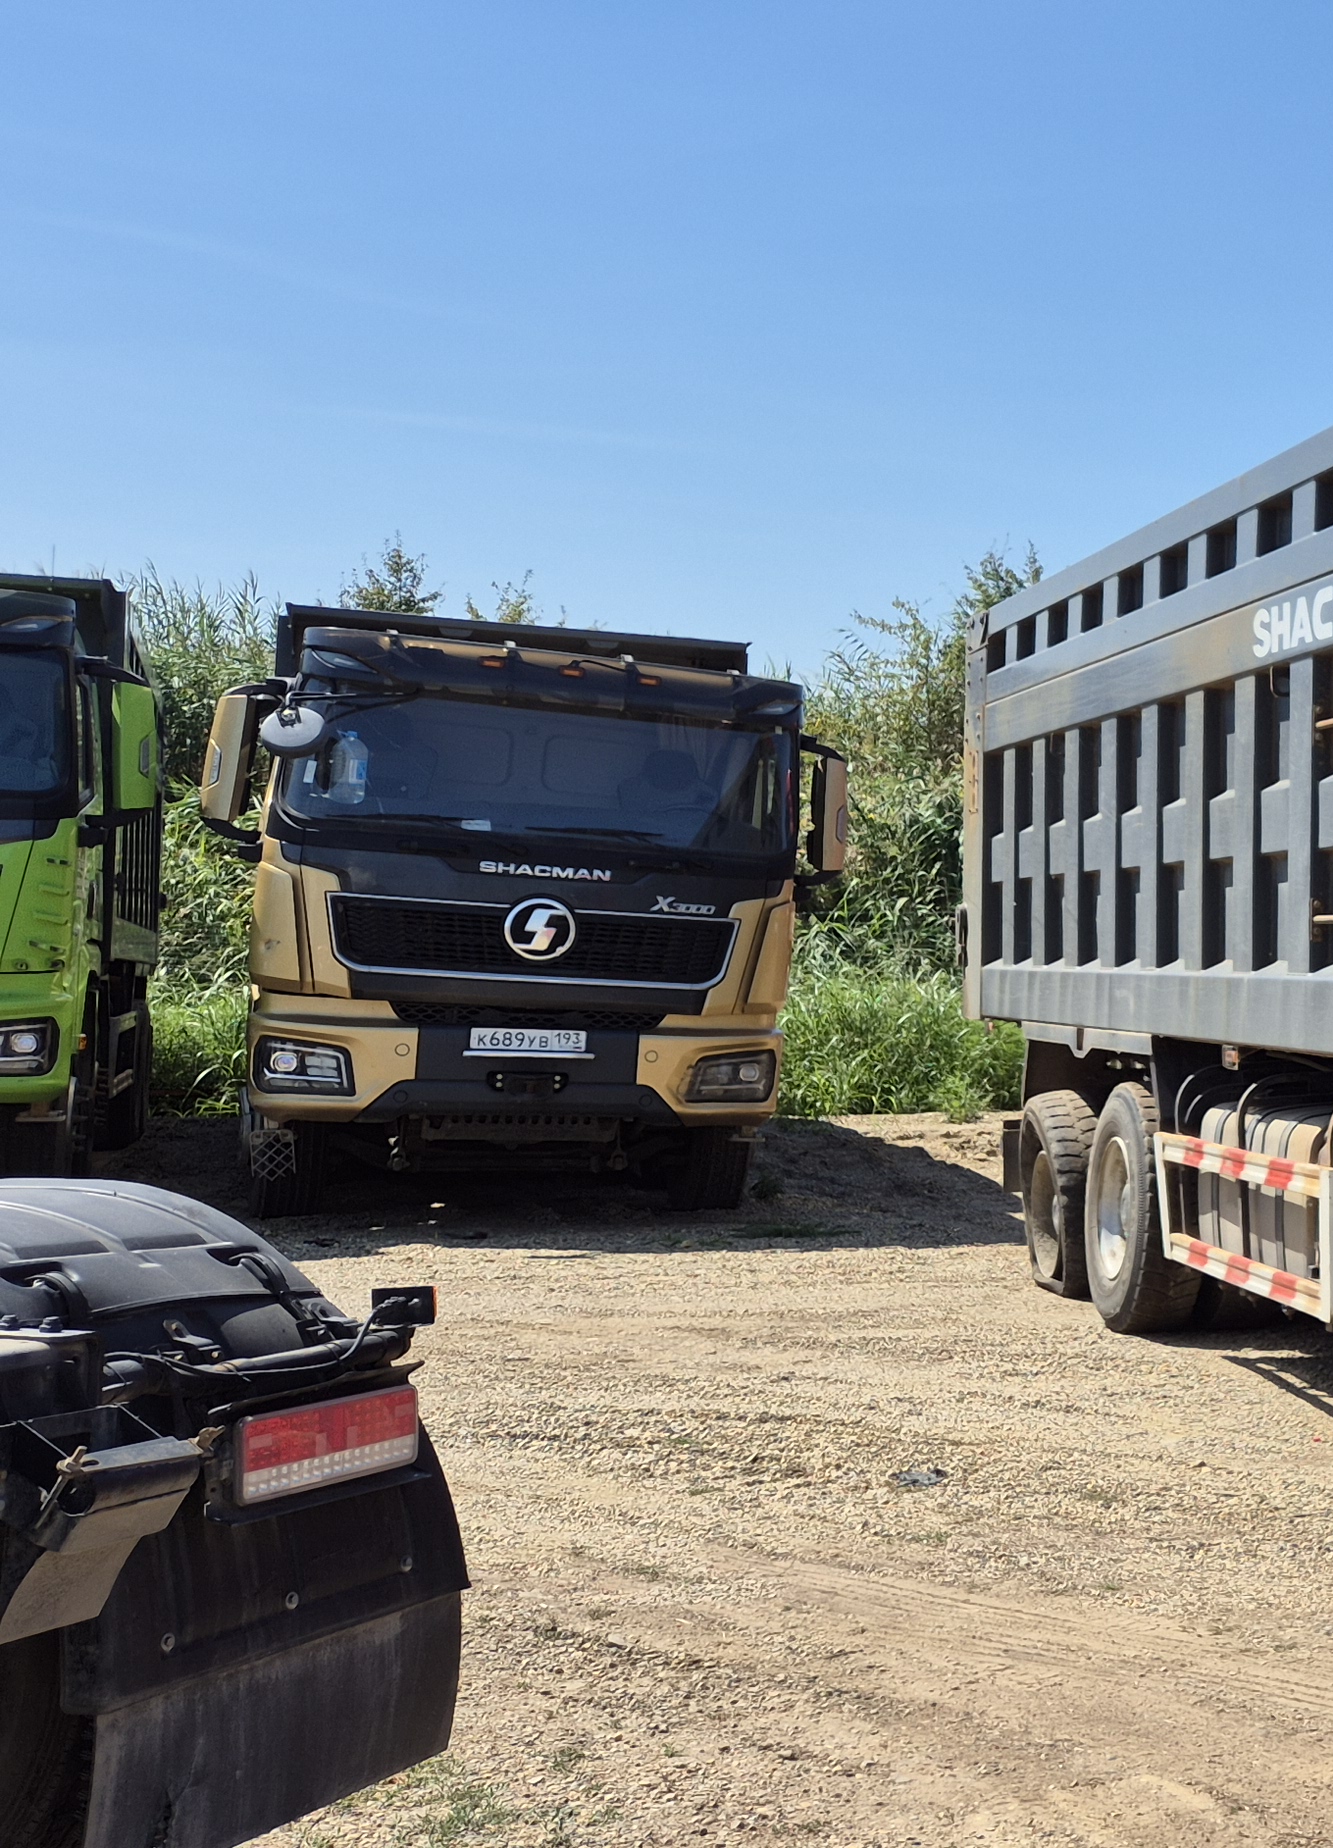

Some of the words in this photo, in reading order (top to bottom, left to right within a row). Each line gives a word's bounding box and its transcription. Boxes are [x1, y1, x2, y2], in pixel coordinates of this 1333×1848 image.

[479, 860, 612, 881] SHACMAN
[649, 894, 716, 915] X3000
[554, 1032, 581, 1045] 193
